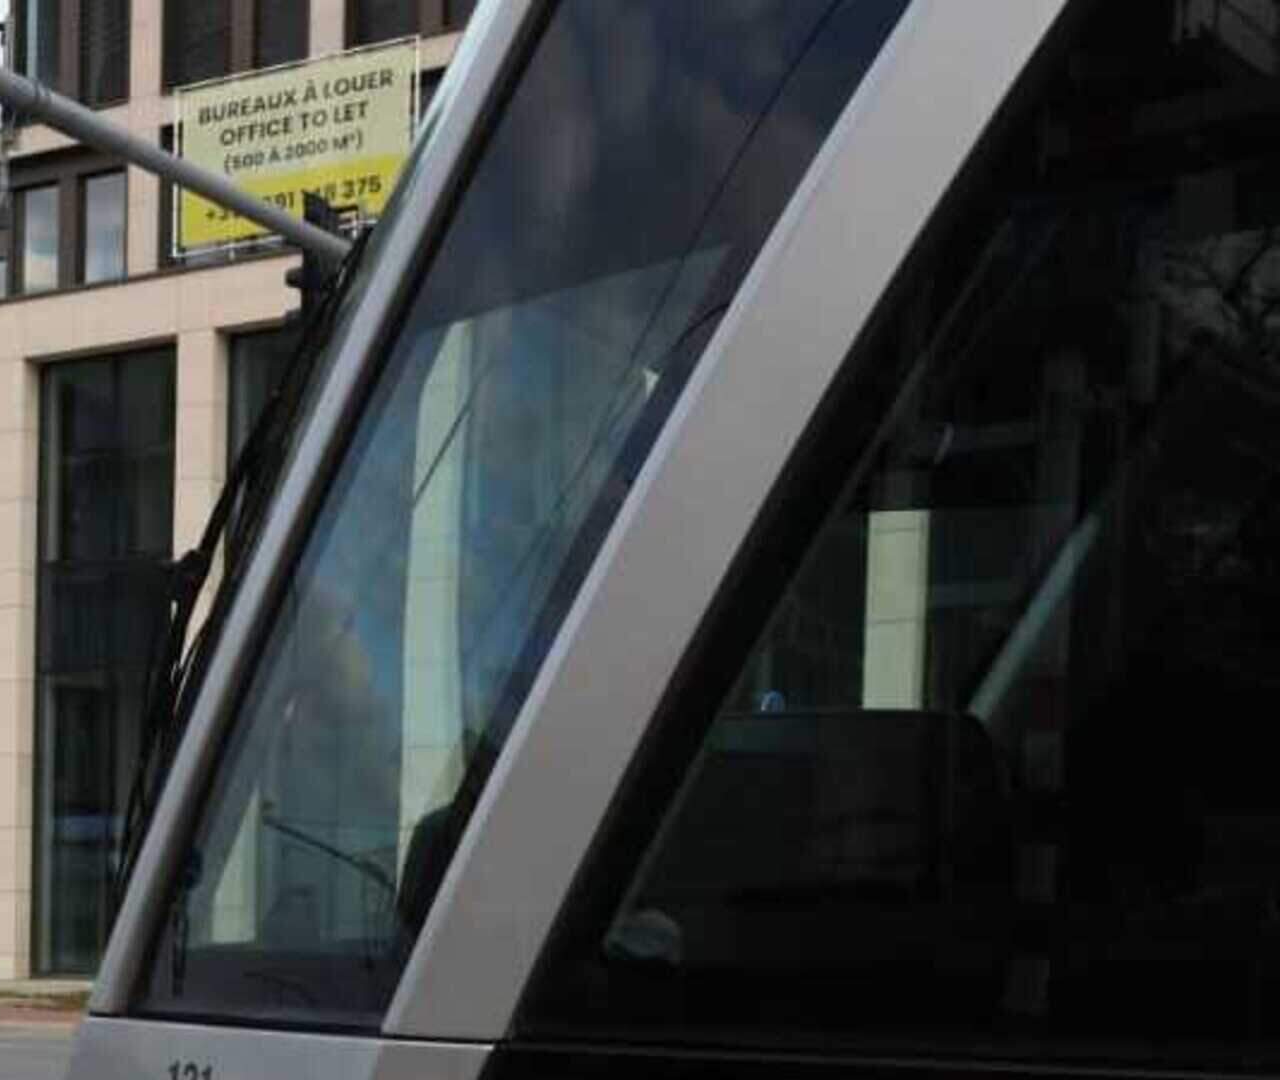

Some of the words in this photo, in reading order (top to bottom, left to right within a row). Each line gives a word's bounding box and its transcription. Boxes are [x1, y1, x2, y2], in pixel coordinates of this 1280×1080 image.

[198, 88, 298, 126] BUREAUX
[303, 79, 318, 102] À
[323, 68, 394, 97] LOUER
[219, 116, 293, 146] OFFICE
[302, 108, 328, 131] TO
[334, 100, 369, 124] LET
[342, 174, 382, 200] 375
